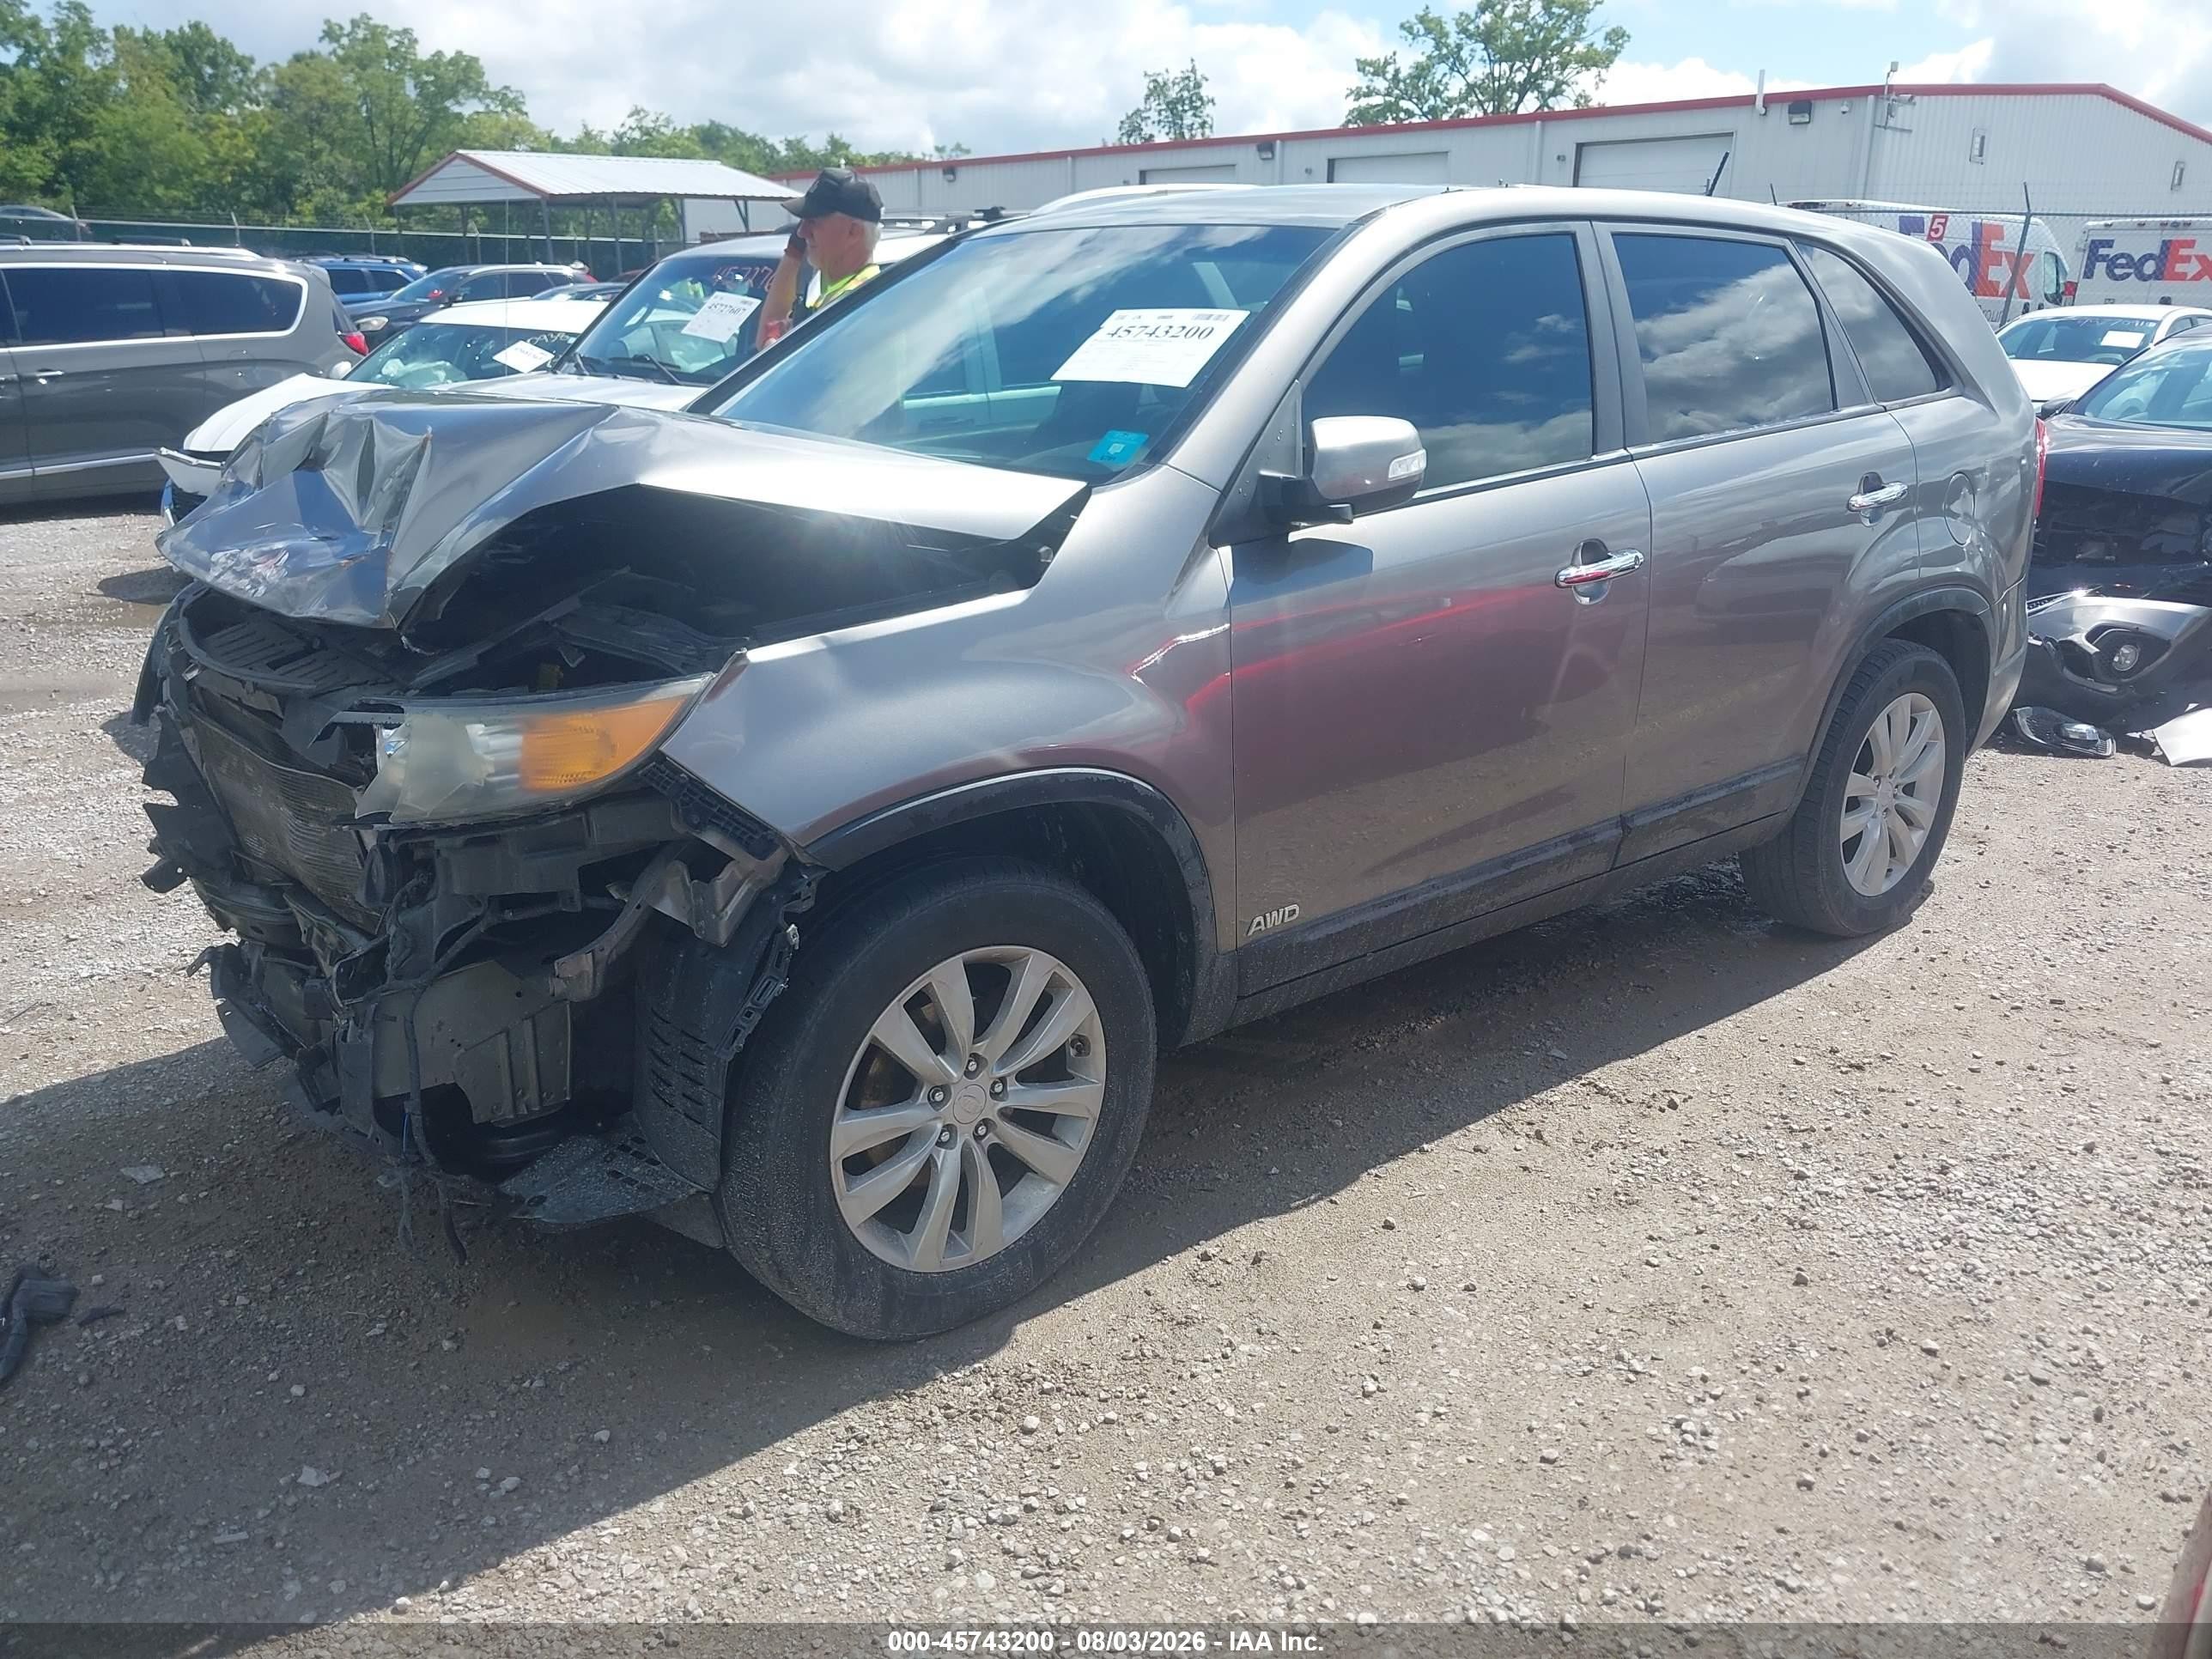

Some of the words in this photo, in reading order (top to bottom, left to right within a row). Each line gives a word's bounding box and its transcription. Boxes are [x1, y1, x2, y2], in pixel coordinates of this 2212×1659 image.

[1930, 217, 1947, 239] 5
[2082, 239, 2212, 282] FedEx
[1106, 325, 1215, 340] 45743200
[1247, 903, 1300, 936] AWD
